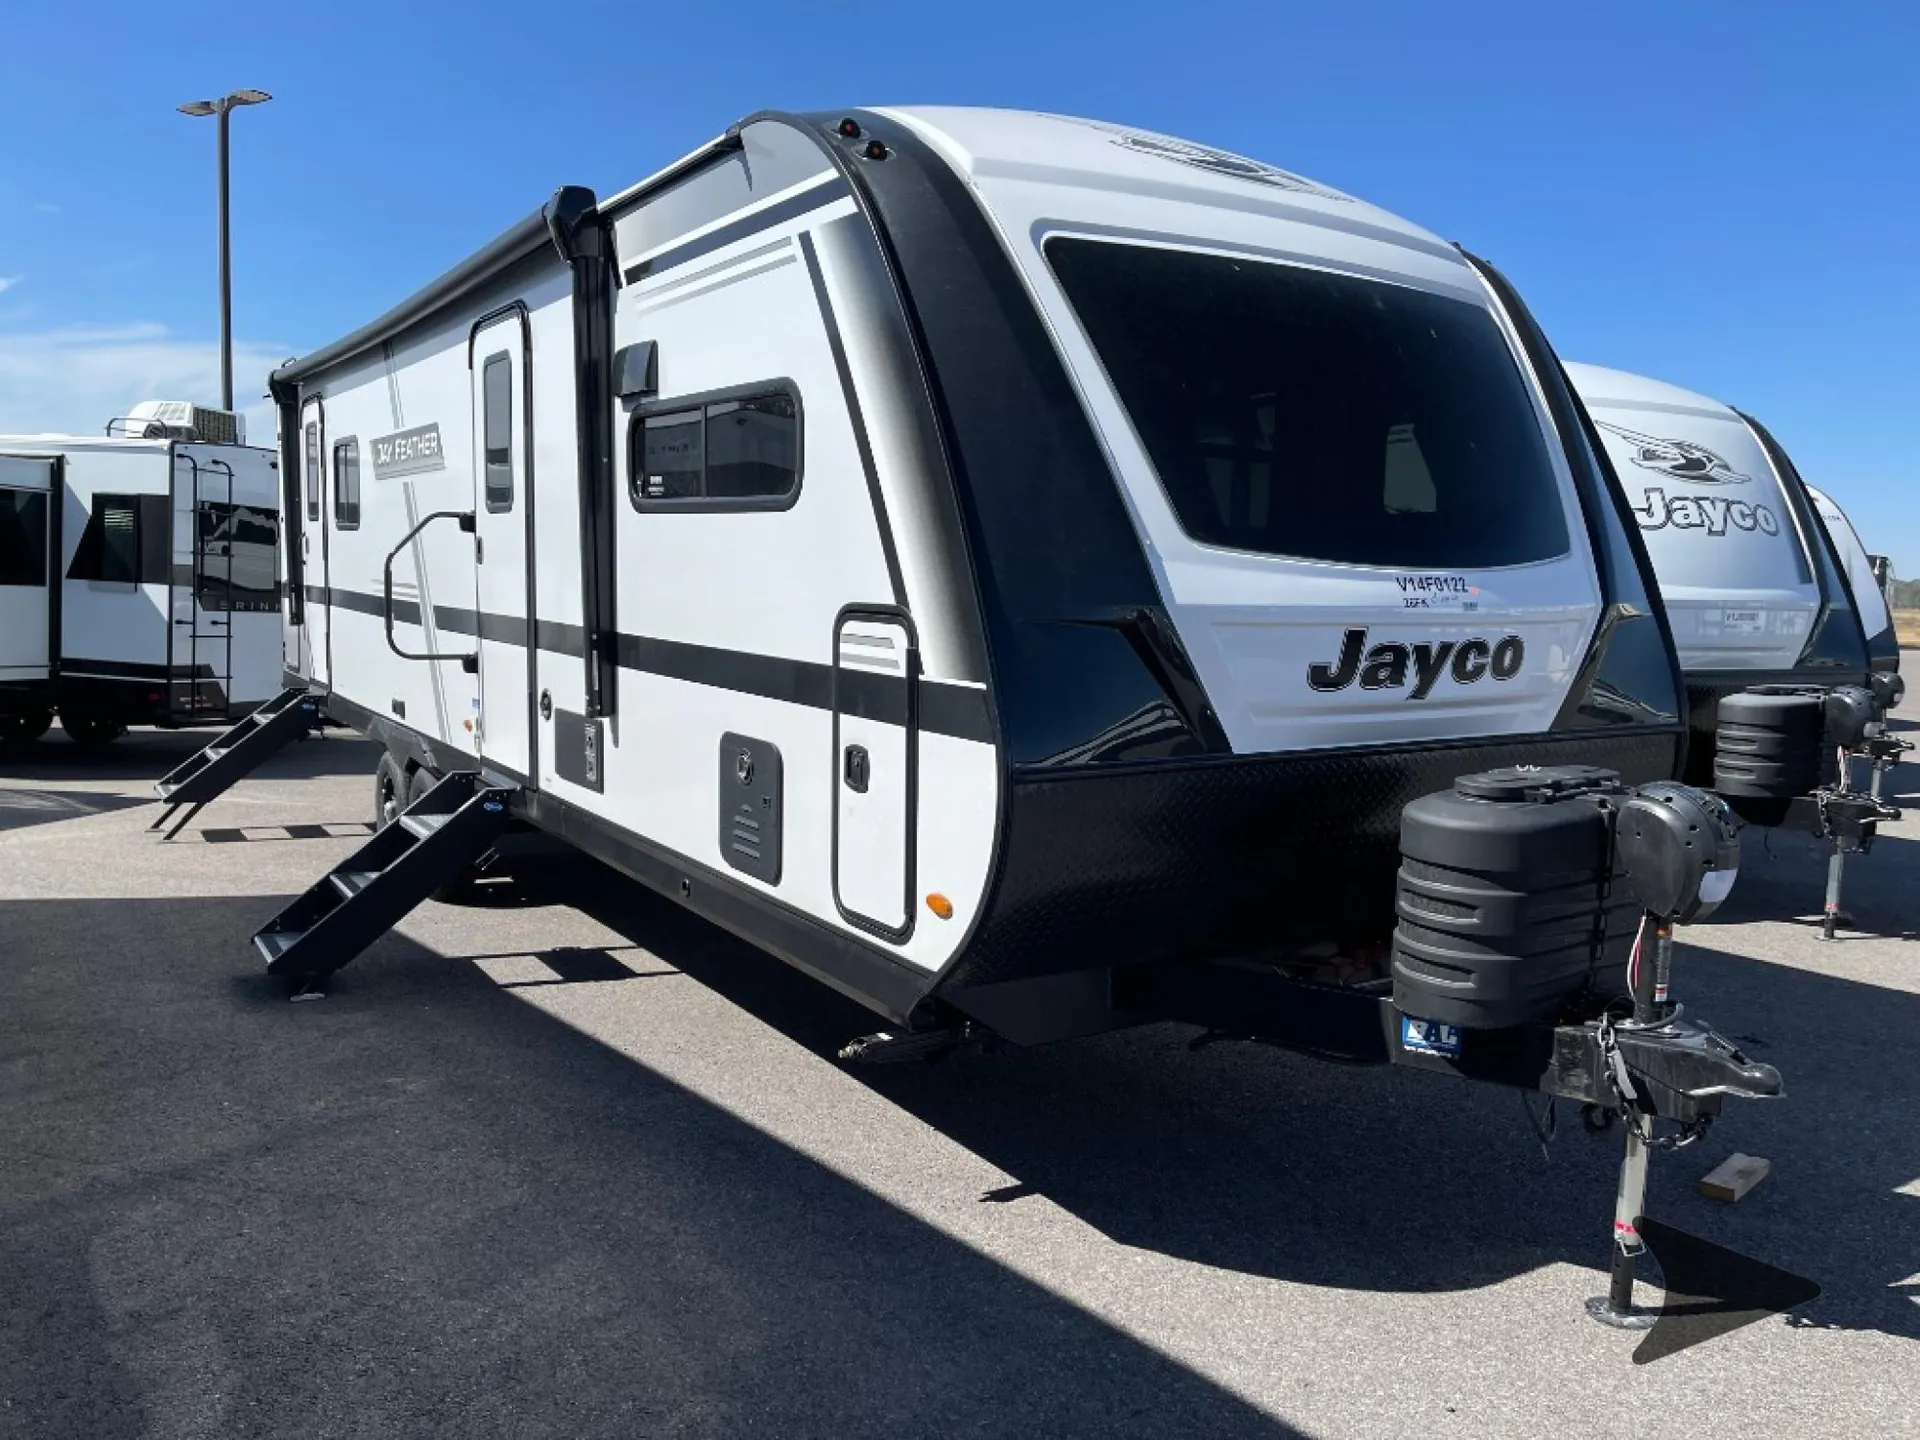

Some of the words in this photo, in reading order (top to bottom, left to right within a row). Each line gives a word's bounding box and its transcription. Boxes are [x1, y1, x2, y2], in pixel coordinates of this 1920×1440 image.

[395, 431, 438, 461] FEATHER
[1632, 487, 1779, 536] Jayco
[1307, 626, 1525, 700] Jayco
